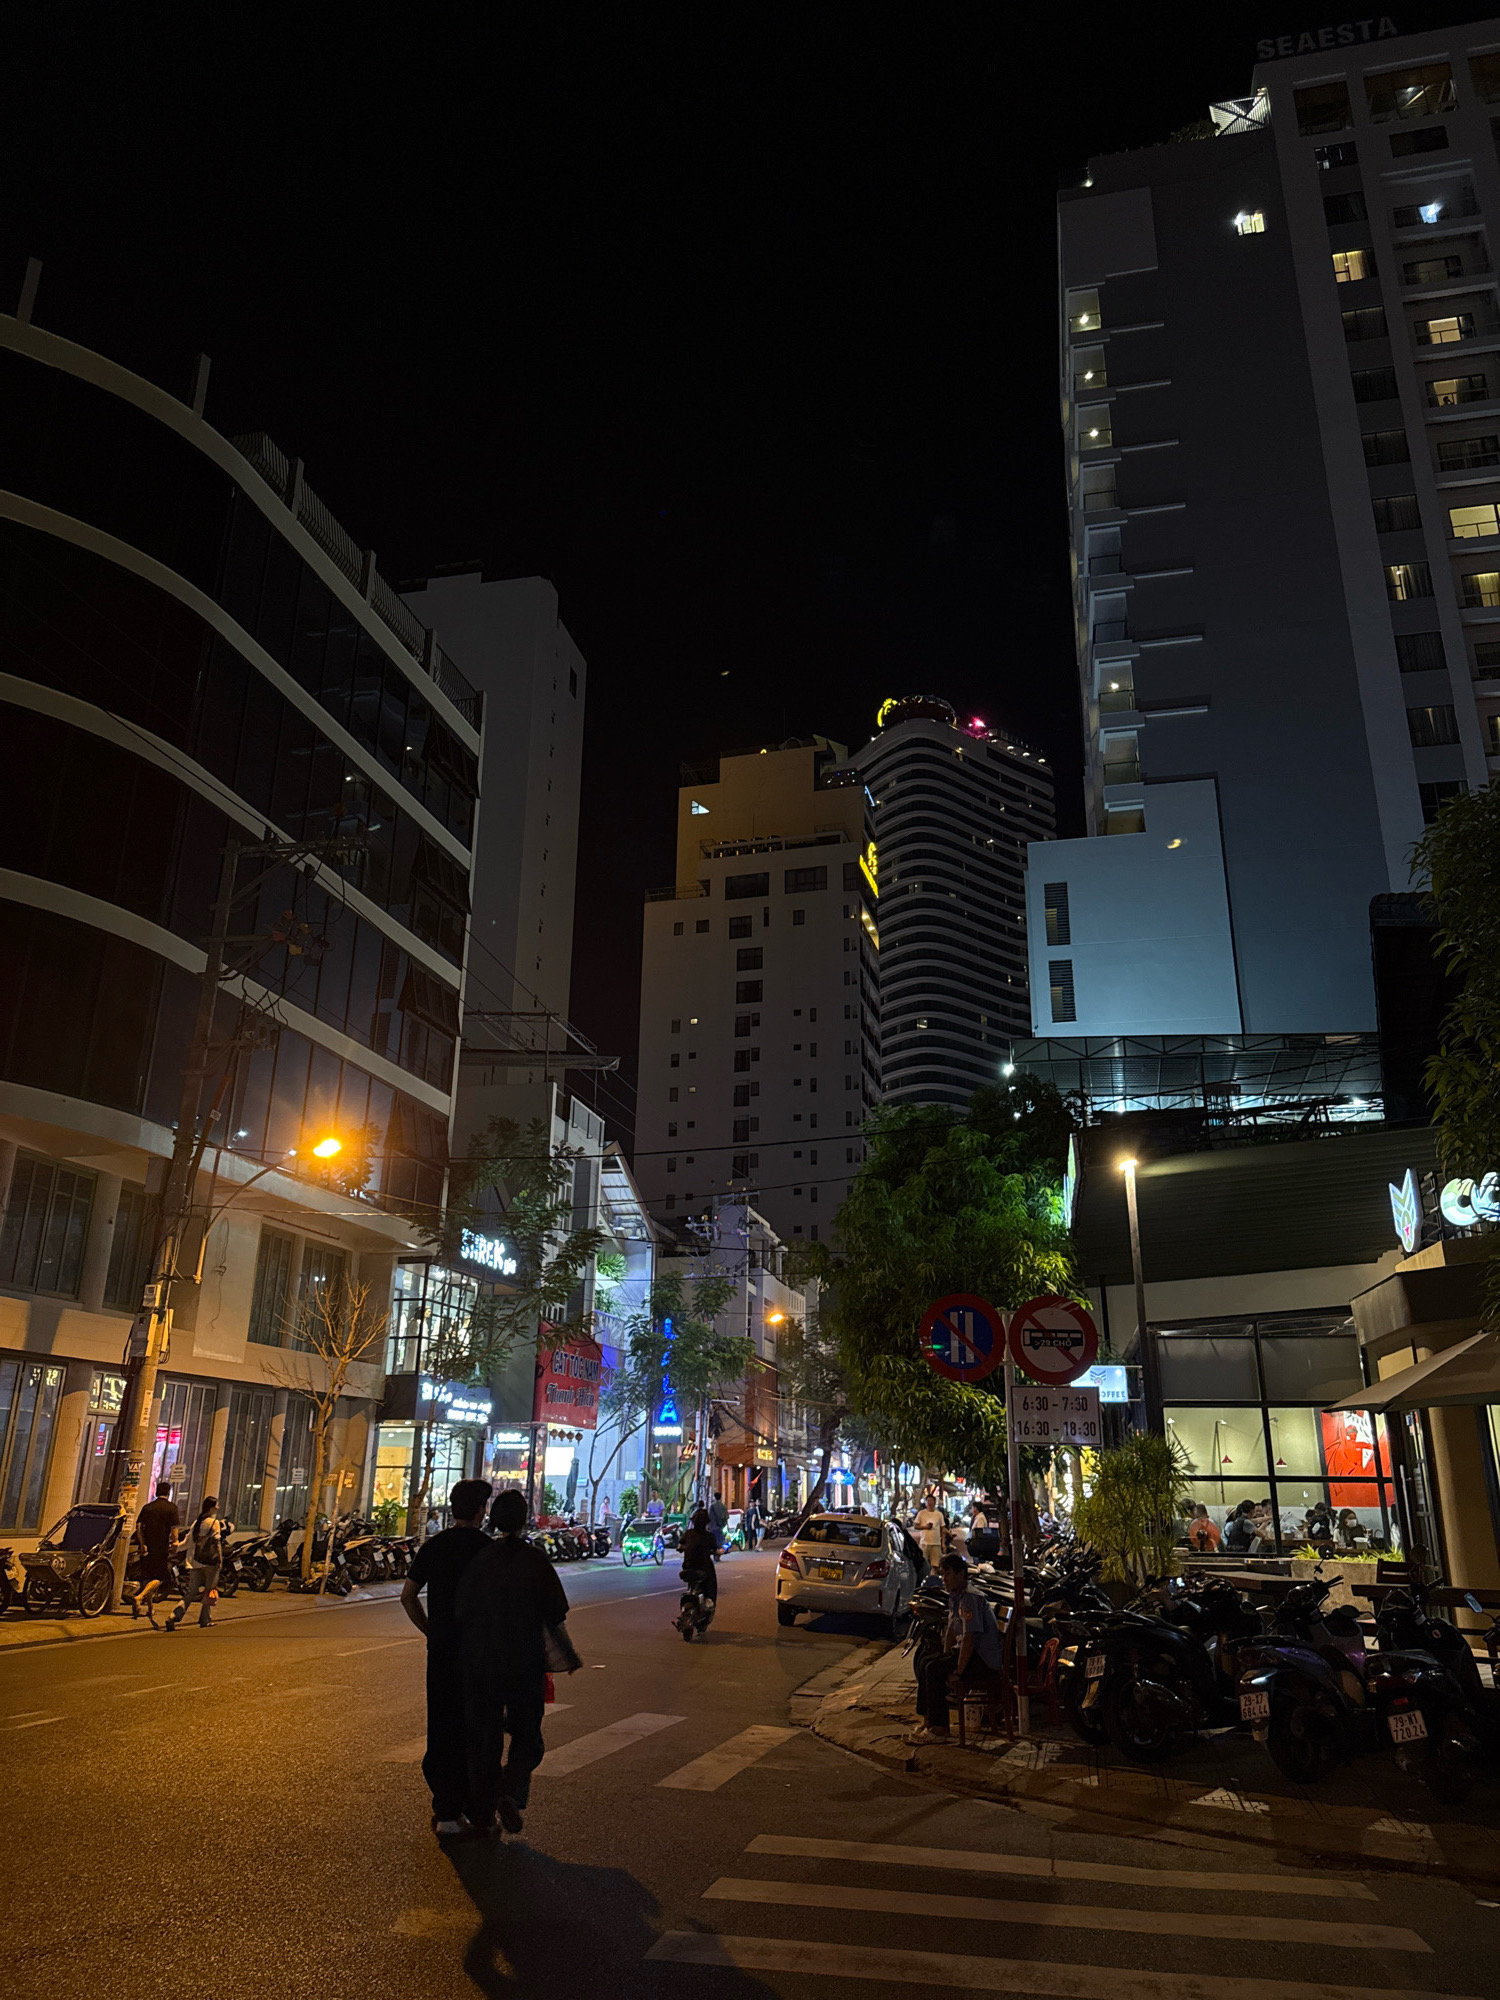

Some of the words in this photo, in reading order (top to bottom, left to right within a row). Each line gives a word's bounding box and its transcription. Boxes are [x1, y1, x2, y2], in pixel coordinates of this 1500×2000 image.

[1256, 16, 1398, 59] SEAESTA
[1100, 1391, 1126, 1399] OFFEE
[1022, 1396, 1049, 1411] 6:30
[1062, 1396, 1088, 1412] 7:30
[1017, 1420, 1050, 1436] 16:30
[1063, 1421, 1097, 1437] 18:30
[1243, 1693, 1264, 1707] 29-X7
[1393, 1712, 1418, 1728] 79-N1
[1393, 1724, 1425, 1740] 720.24
